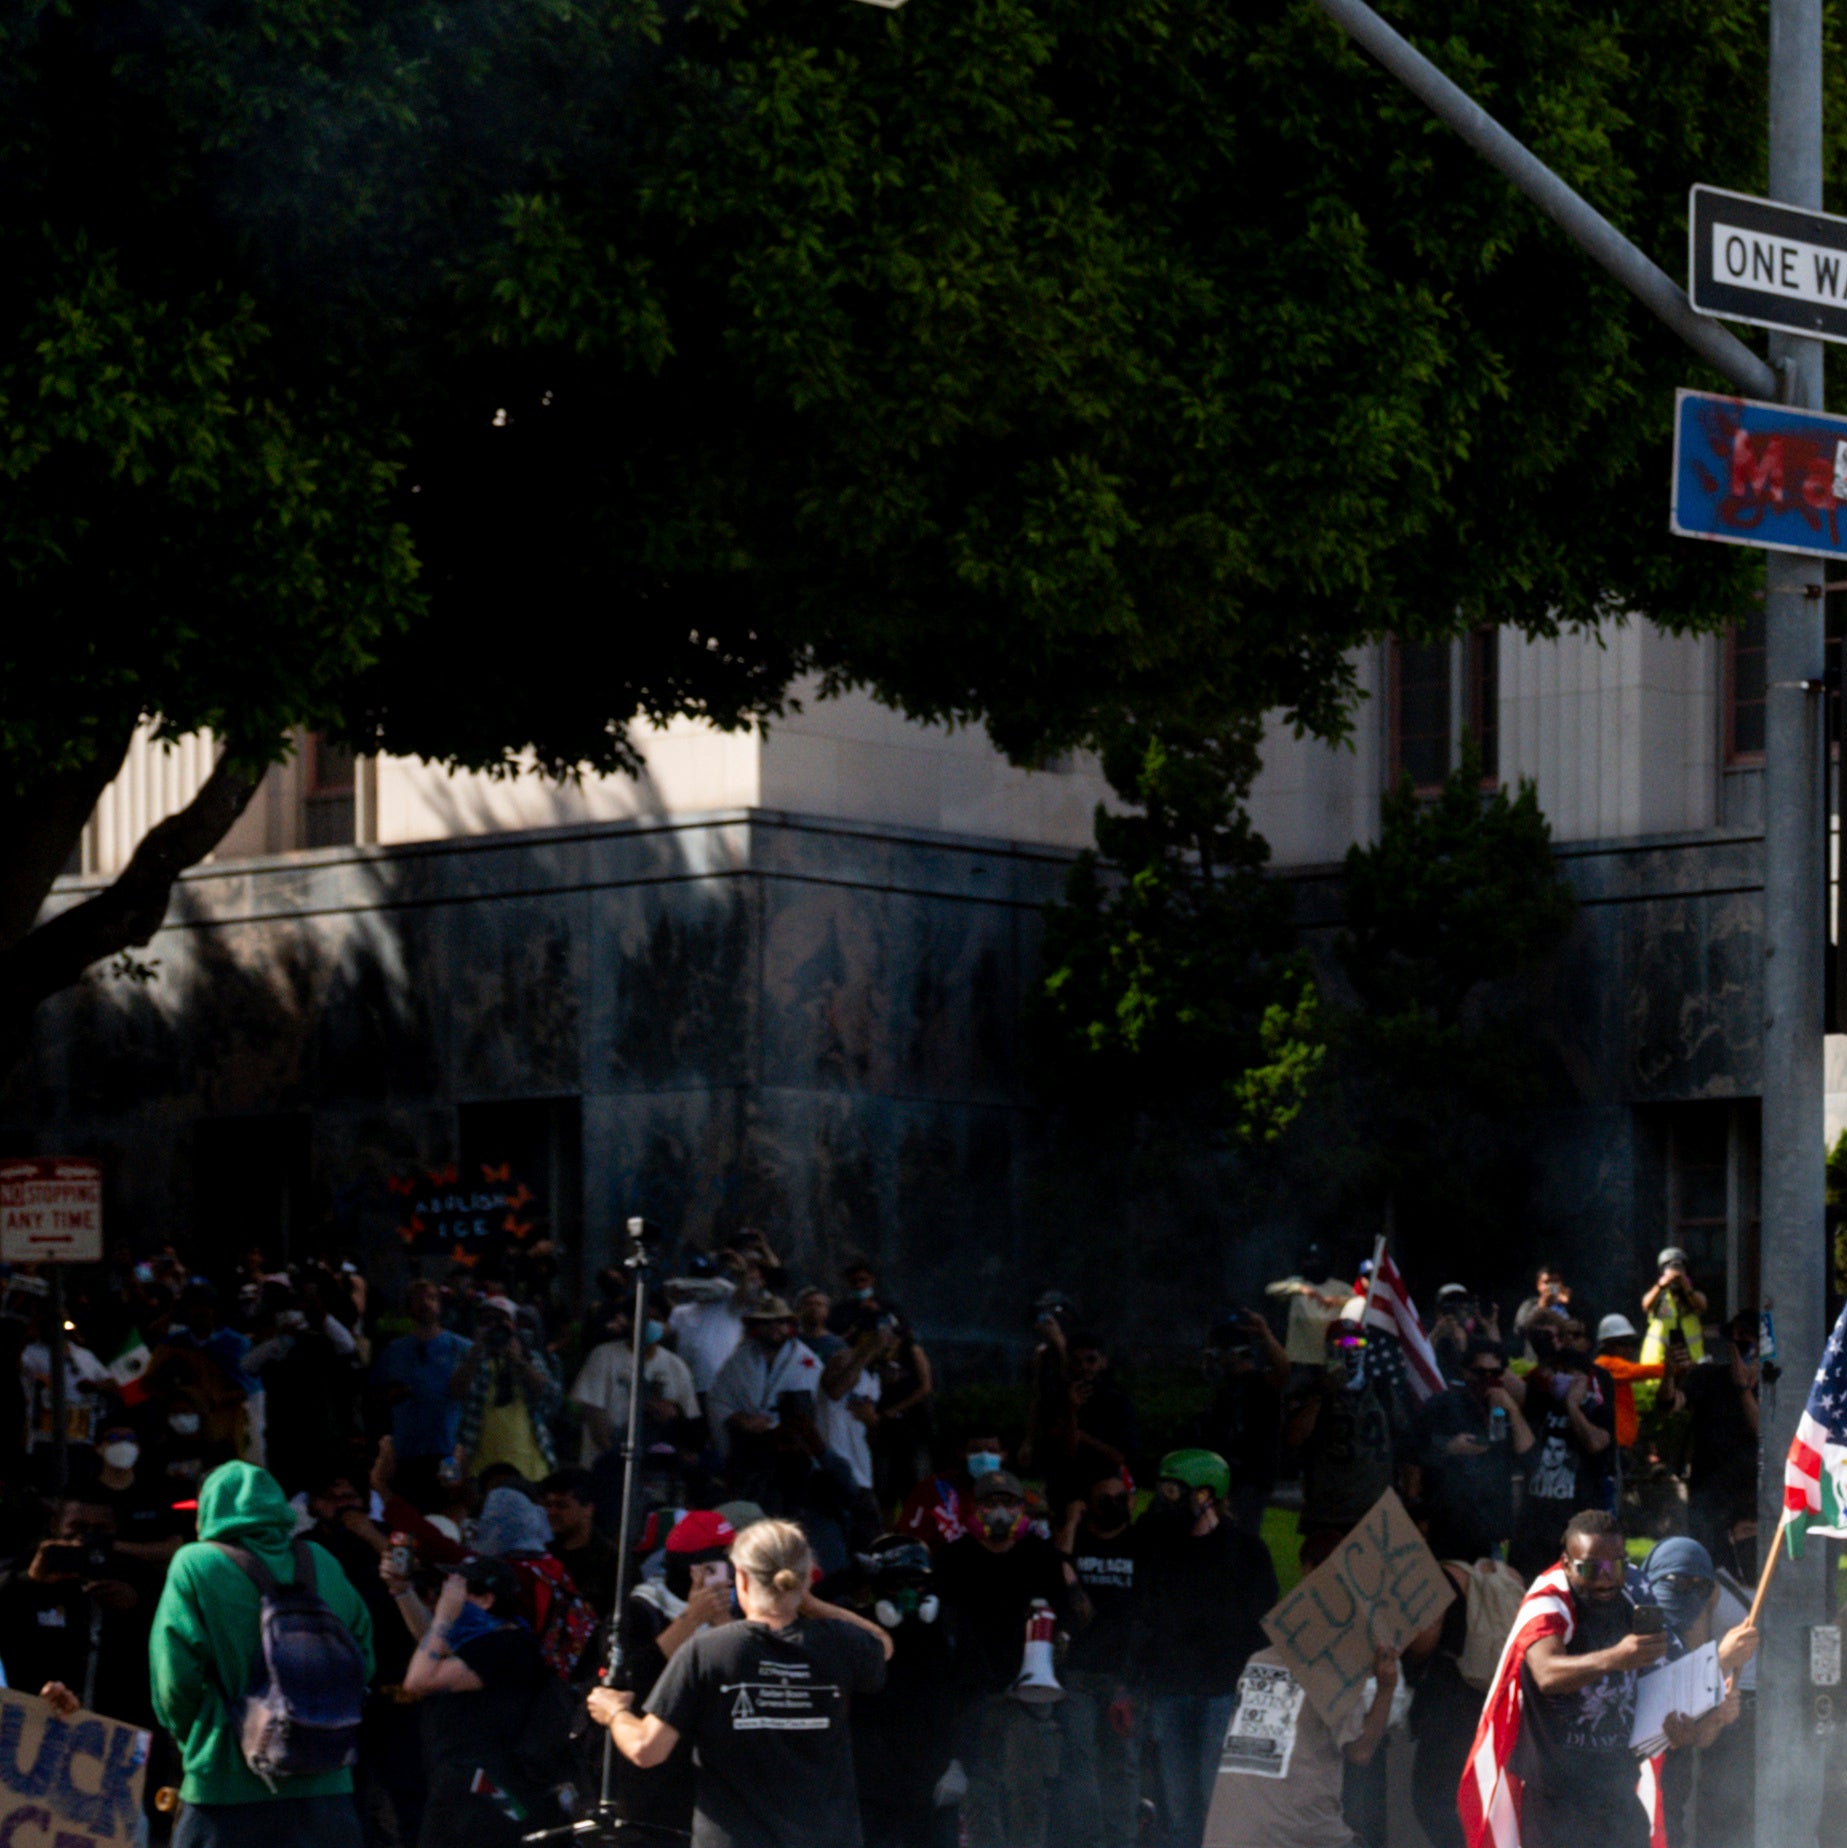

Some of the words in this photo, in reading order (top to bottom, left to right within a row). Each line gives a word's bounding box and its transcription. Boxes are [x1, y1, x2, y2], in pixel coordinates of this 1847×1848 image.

[1725, 235, 1800, 290] ONE
[27, 1185, 97, 1202] STOPPING
[7, 1211, 43, 1231] ANY
[53, 1209, 95, 1230] TIME
[438, 1218, 488, 1238] ICE
[1076, 1556, 1134, 1574] MPEACH
[1274, 1509, 1420, 1665] FUCK
